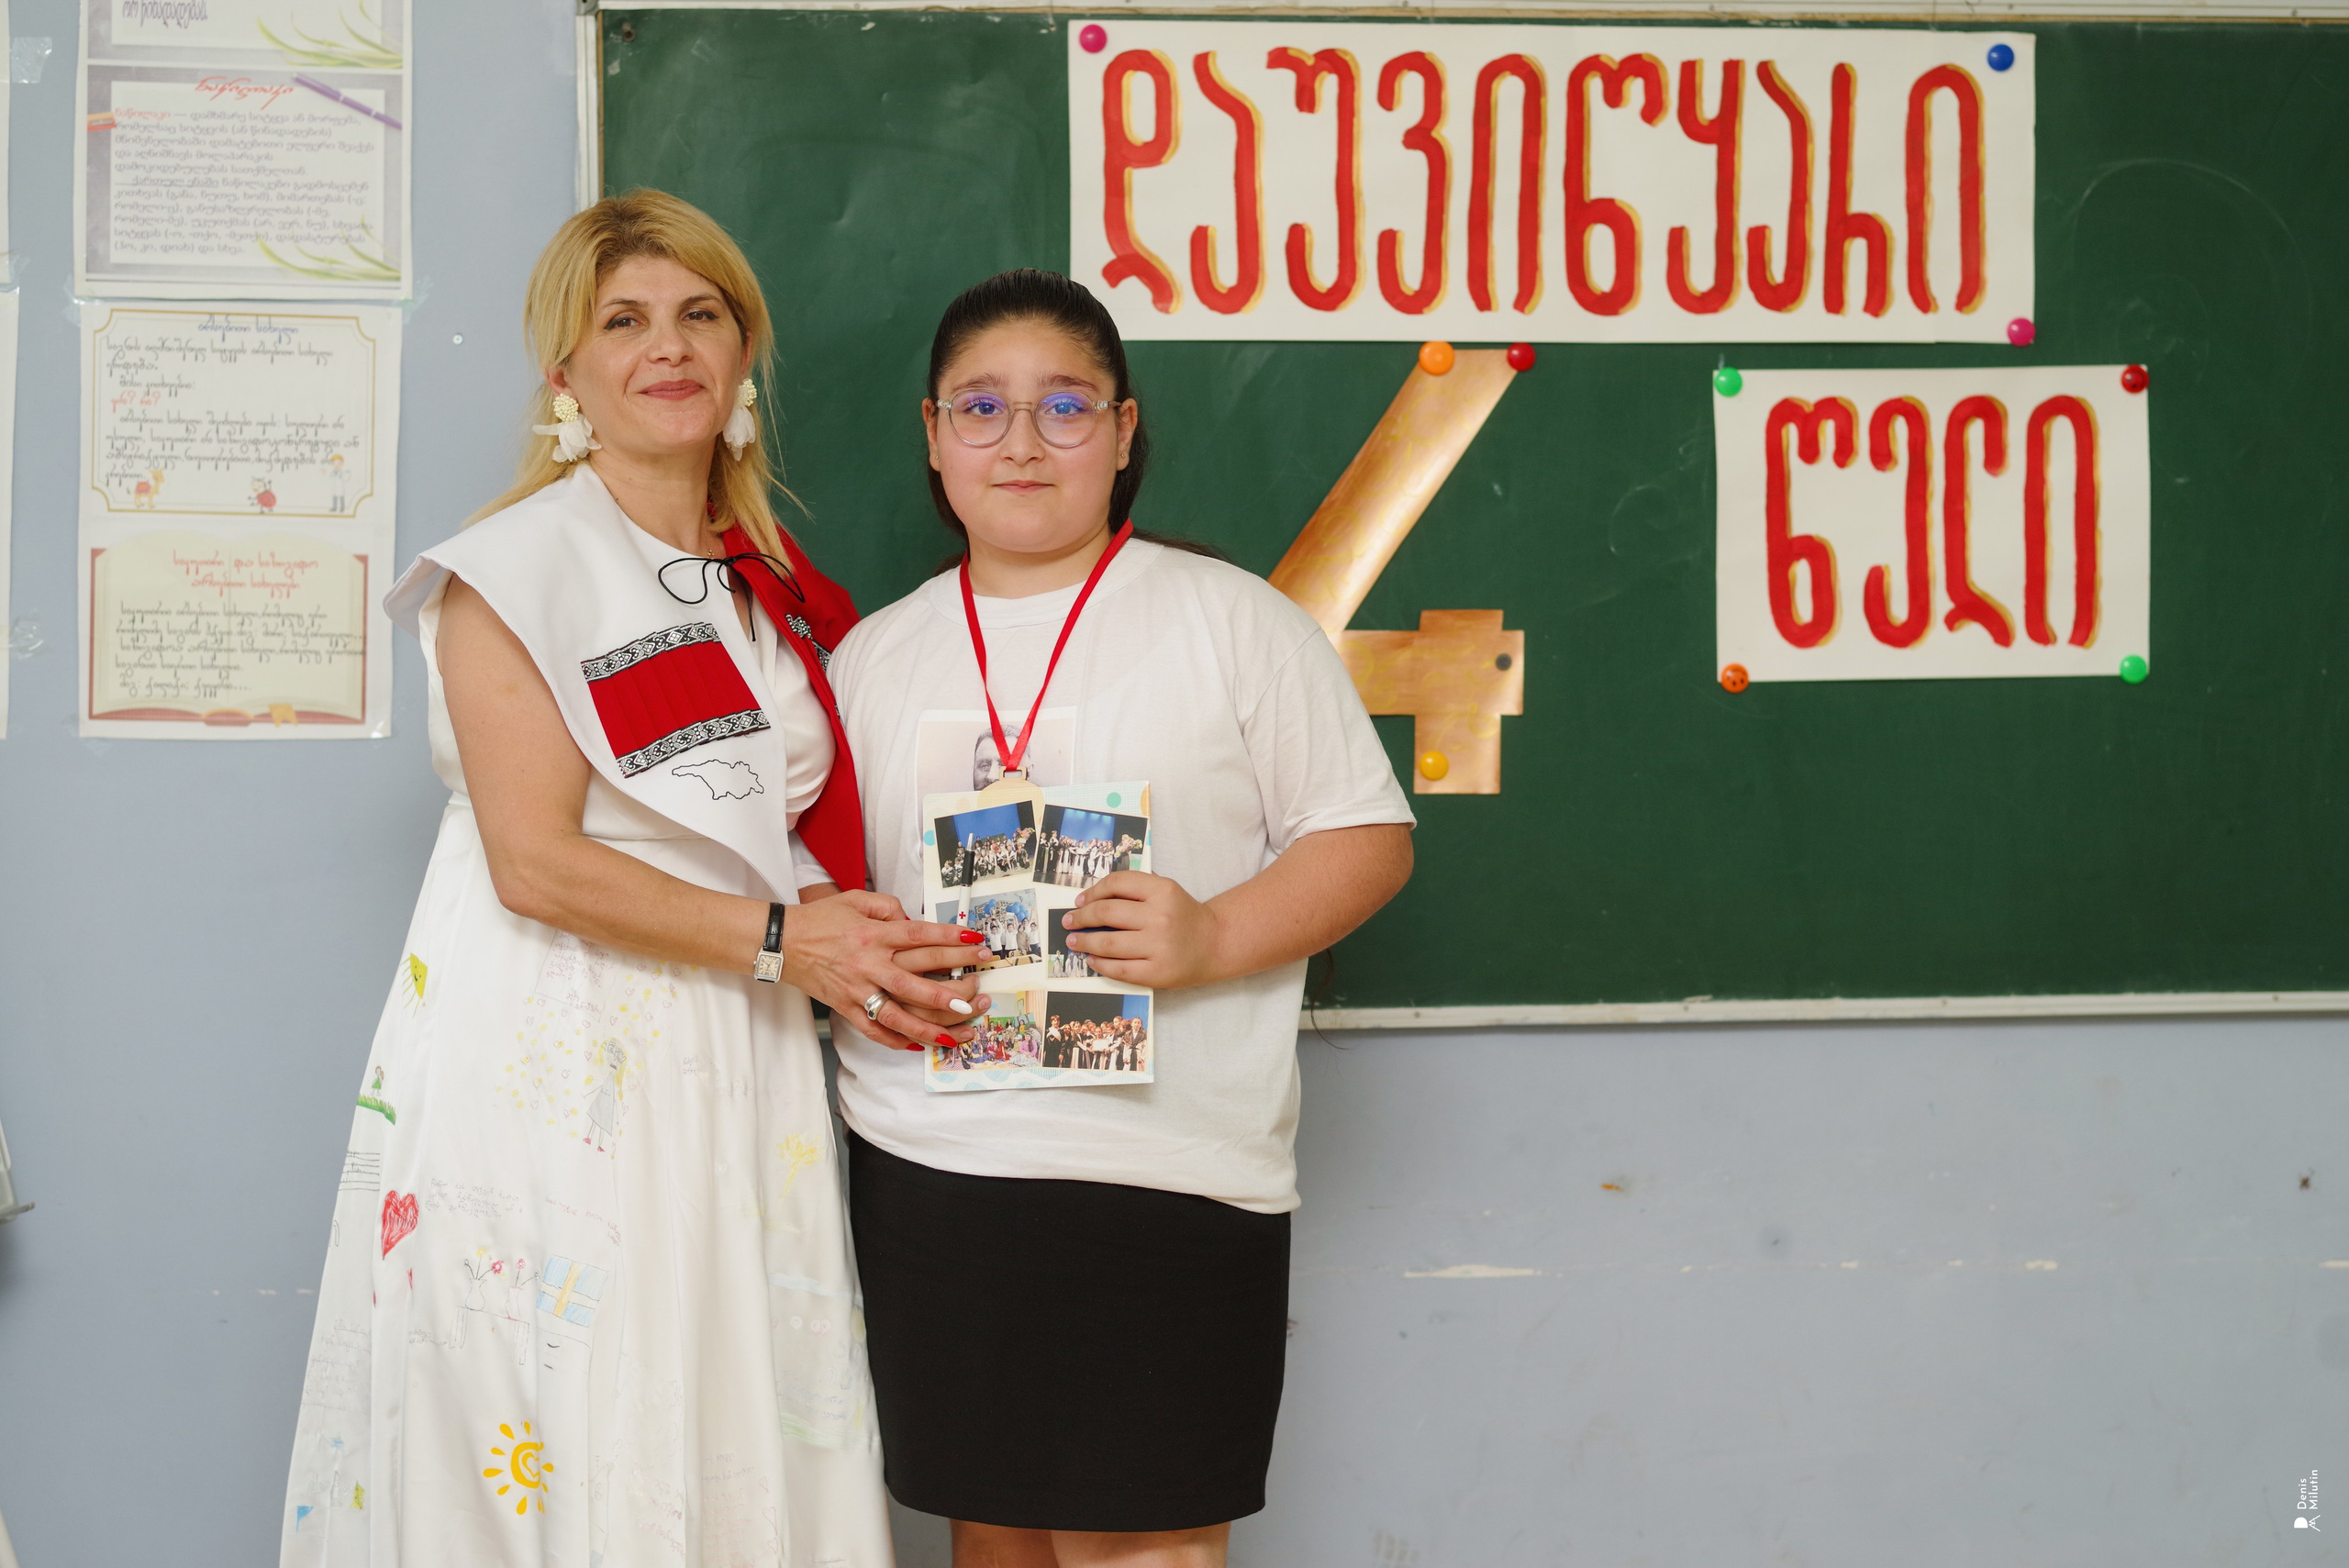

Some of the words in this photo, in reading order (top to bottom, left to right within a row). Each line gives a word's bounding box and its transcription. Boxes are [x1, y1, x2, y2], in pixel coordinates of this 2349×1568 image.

[115, 150, 131, 159] და
[294, 114, 305, 122] ან
[1101, 45, 1987, 317] დაუვიწყარი
[1765, 395, 2100, 649] წელი
